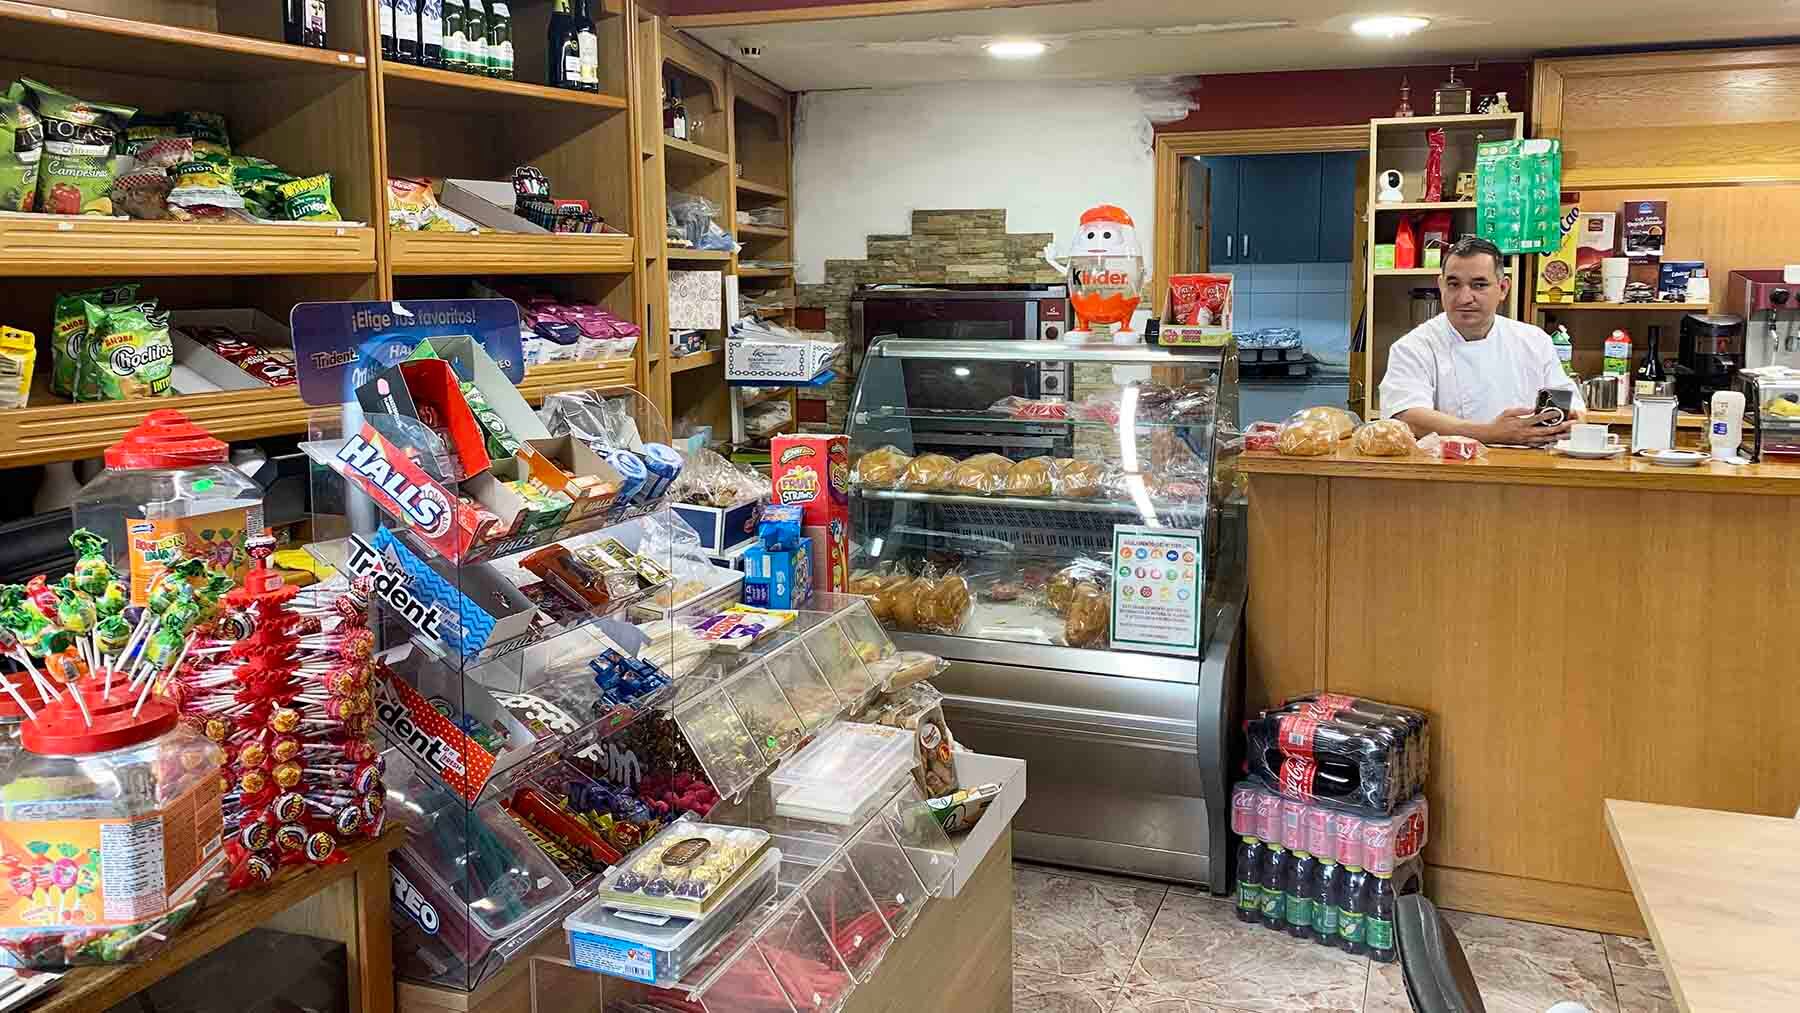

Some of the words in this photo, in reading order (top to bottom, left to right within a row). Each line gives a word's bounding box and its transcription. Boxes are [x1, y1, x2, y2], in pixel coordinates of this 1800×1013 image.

[1559, 207, 1580, 234] Cao
[352, 311, 391, 332] ¡Elige
[417, 307, 476, 326] favoritos!
[110, 345, 174, 376] Choclitos
[312, 351, 360, 369] Trident
[337, 434, 442, 526] HALLS
[782, 489, 814, 503] STRAWS
[349, 533, 442, 641] Trident
